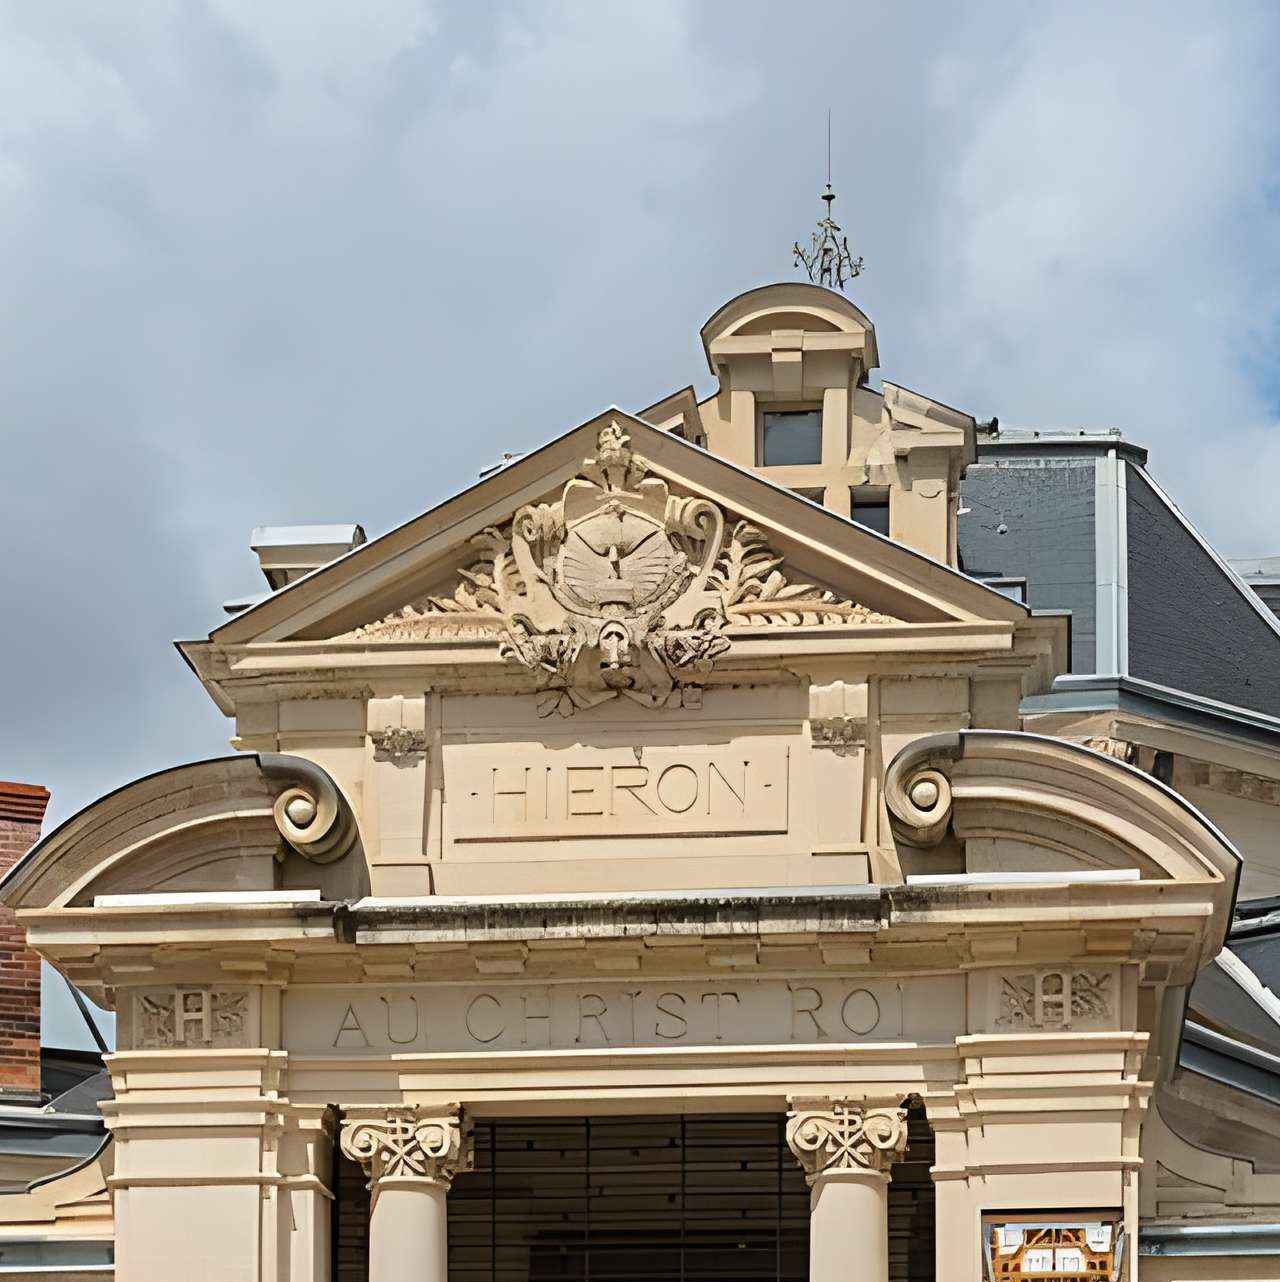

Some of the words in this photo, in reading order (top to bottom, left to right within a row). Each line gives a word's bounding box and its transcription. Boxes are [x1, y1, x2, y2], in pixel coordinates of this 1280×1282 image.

[331, 995, 420, 1049] AU
[465, 989, 741, 1047] CHRIST
[784, 982, 906, 1040] ROI
